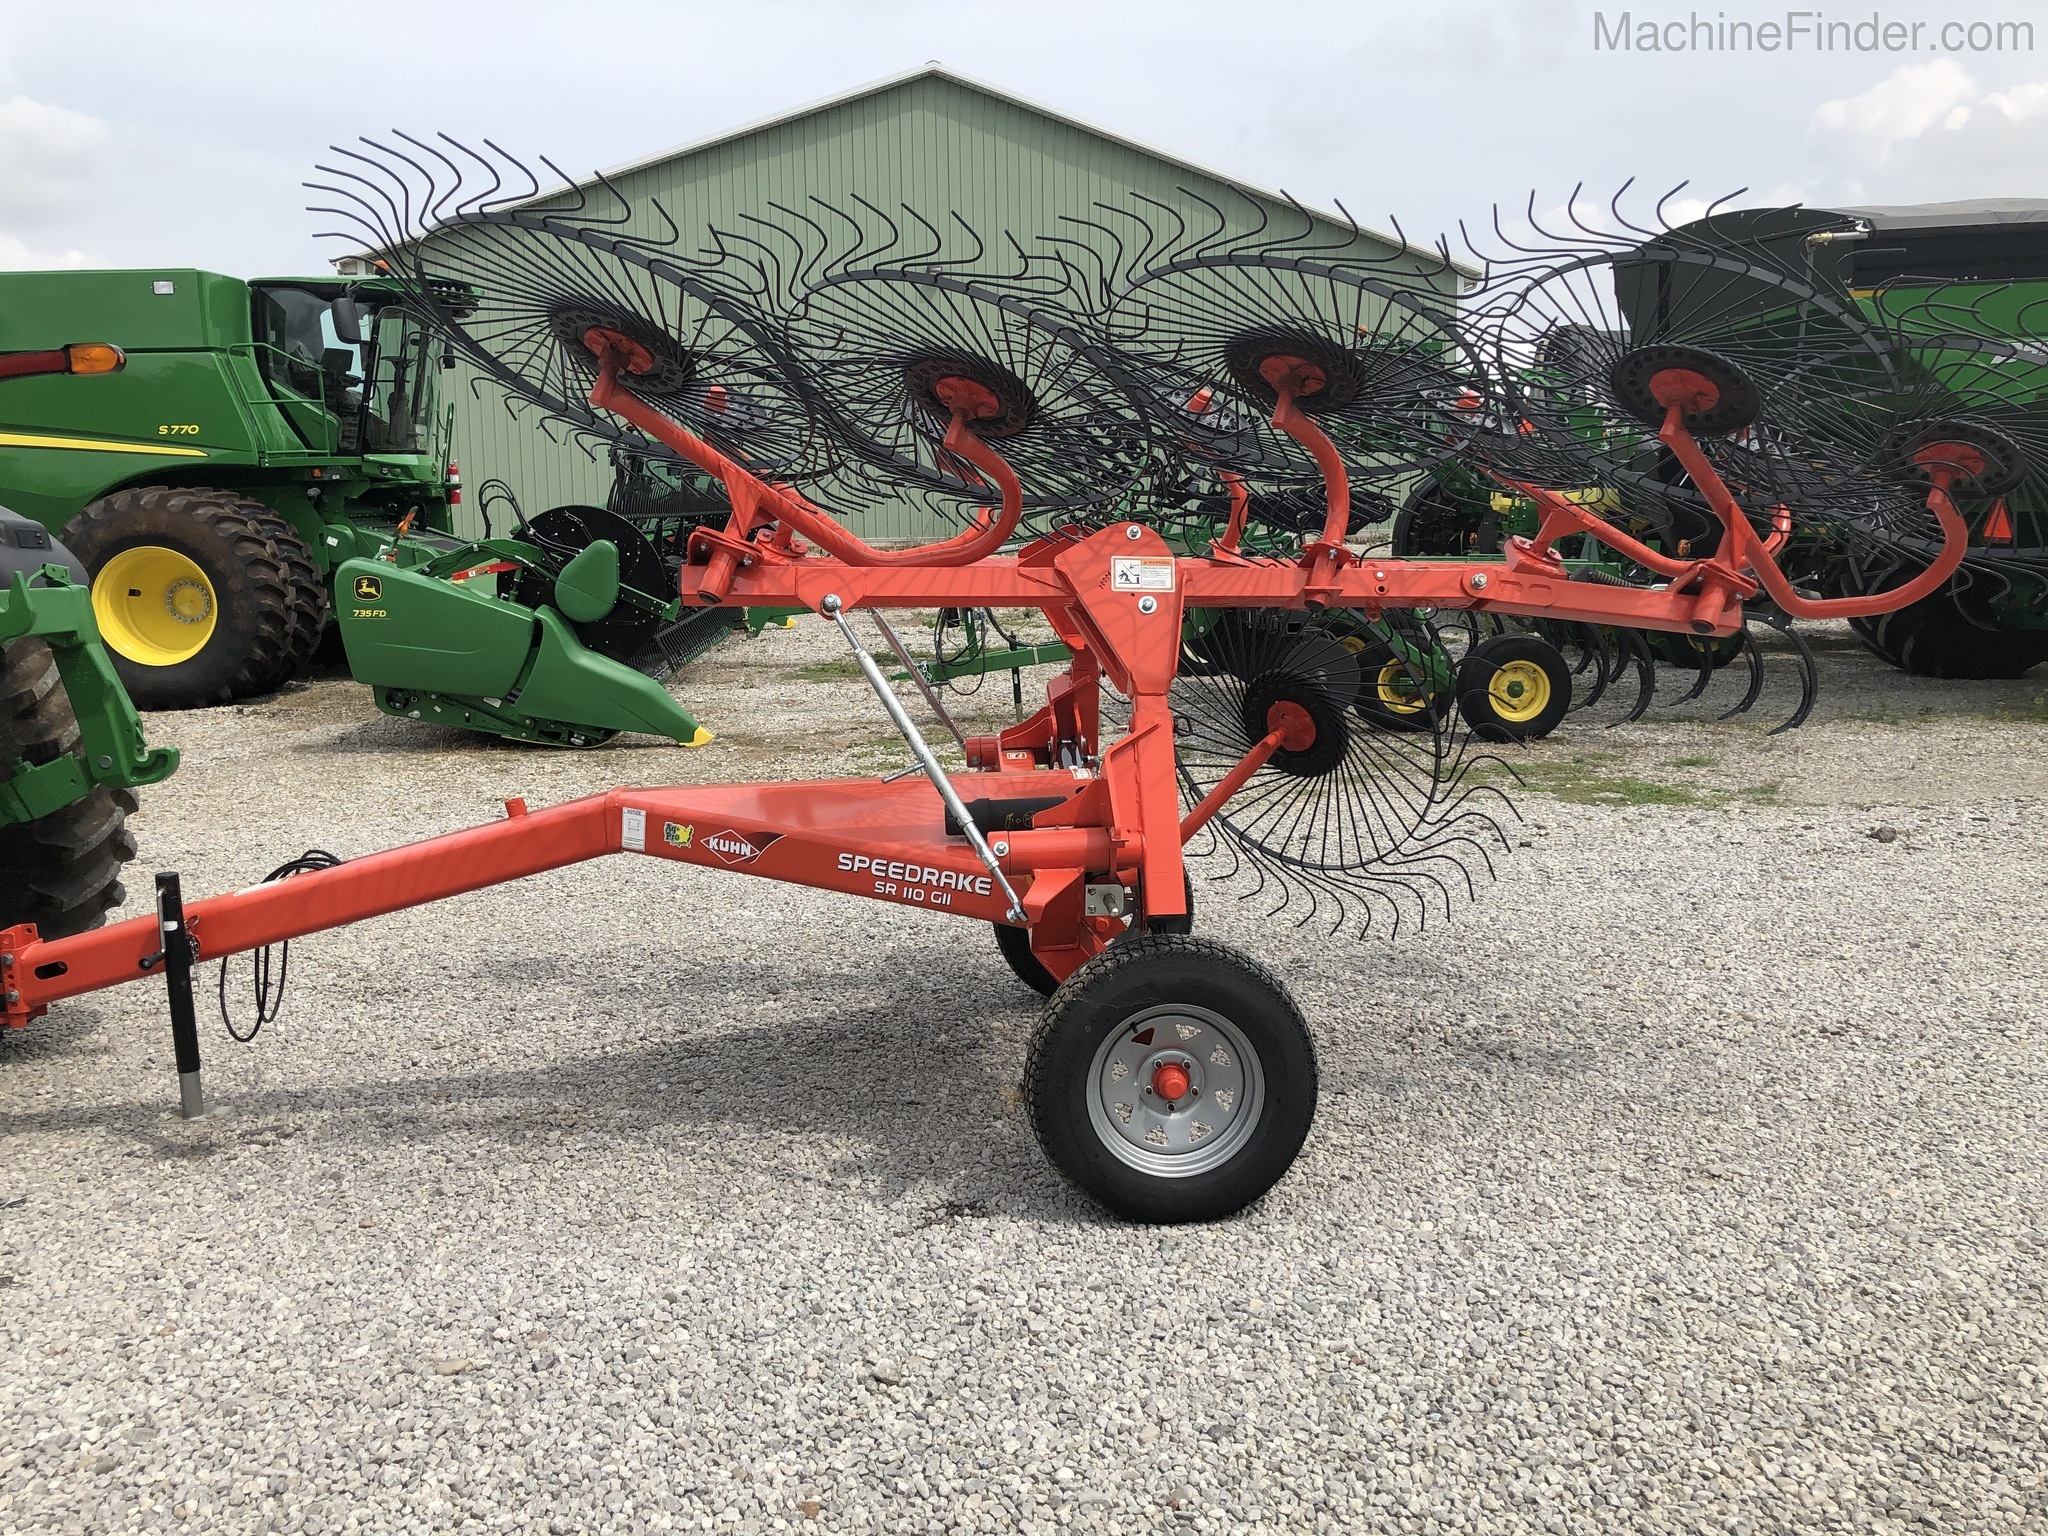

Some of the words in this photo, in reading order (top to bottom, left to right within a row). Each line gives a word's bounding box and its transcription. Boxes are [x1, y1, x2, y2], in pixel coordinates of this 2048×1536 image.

[665, 832, 680, 841] Pro
[709, 837, 751, 857] KUHN
[837, 852, 993, 896] SPEEDRAKE
[874, 881, 897, 896] SR
[902, 886, 925, 902] 110
[930, 891, 952, 906] GII
